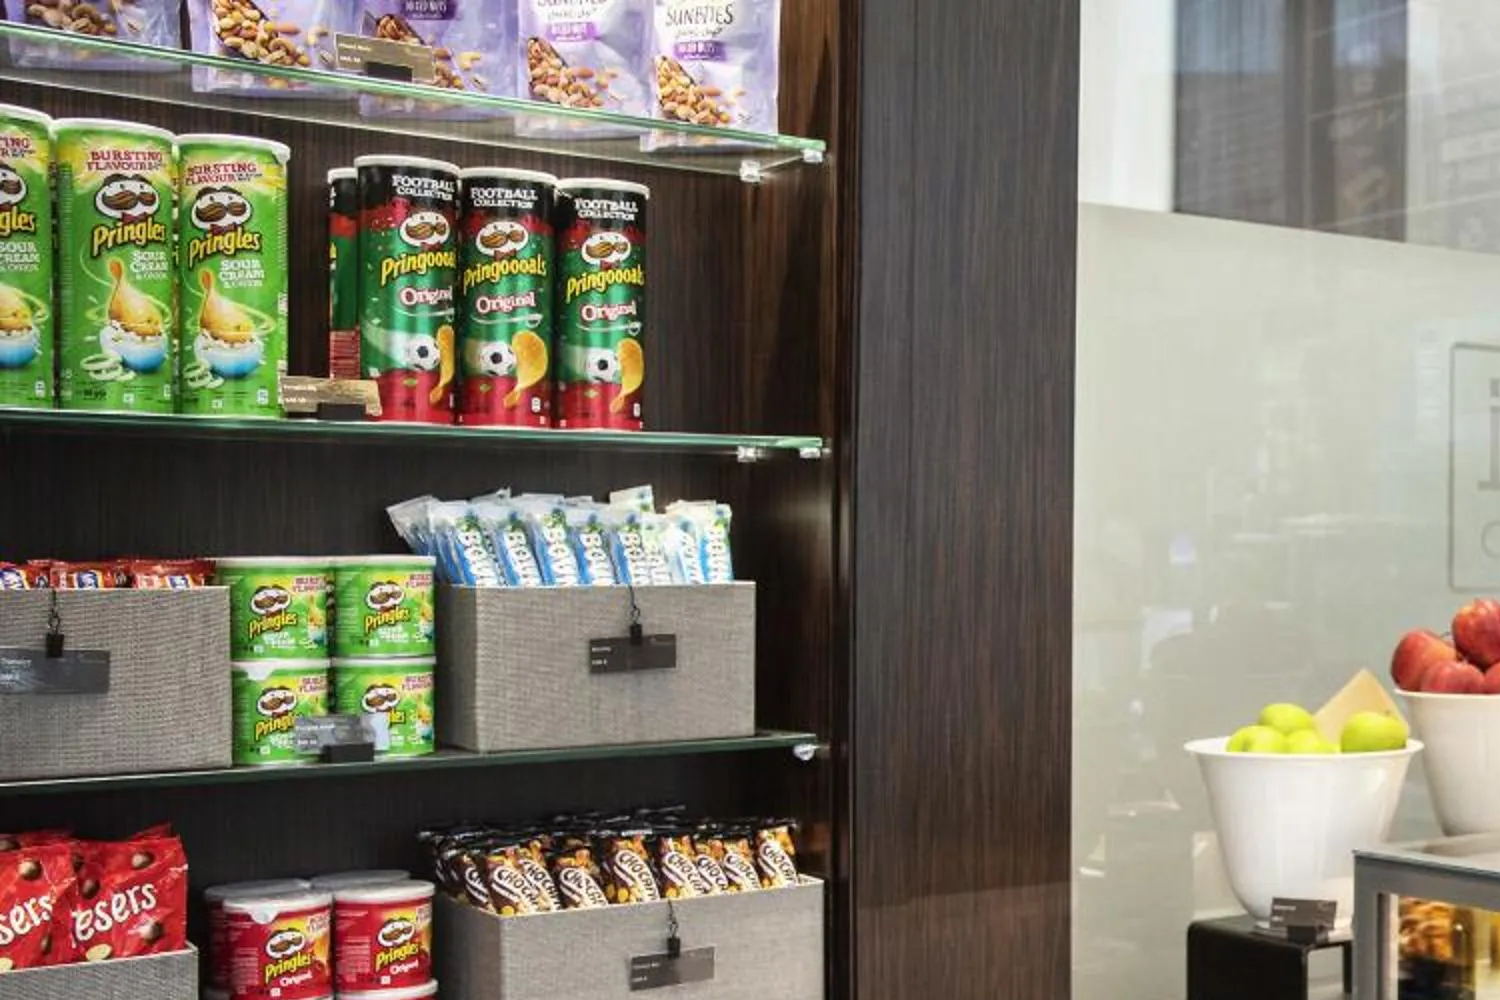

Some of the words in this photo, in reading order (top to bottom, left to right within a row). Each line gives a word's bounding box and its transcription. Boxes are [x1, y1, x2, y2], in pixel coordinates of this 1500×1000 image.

[664, 3, 734, 27] SUNBITES
[0, 136, 31, 149] TING
[89, 150, 164, 162] BURSTING
[186, 163, 257, 176] BURSTING
[392, 174, 455, 193] FOOTBALL
[471, 187, 538, 201] FOOTBALL
[473, 198, 535, 210] COLLECTION
[574, 198, 638, 213] FOOTBALL
[0, 205, 35, 238] gles
[577, 210, 636, 222] COLLECTION
[90, 215, 166, 258] Pringles
[188, 226, 263, 269] Pringles
[220, 258, 262, 270] SOUR
[475, 290, 537, 315] Original
[580, 299, 637, 322] Original
[248, 607, 297, 639] Pringles
[364, 604, 411, 633] Pringles
[74, 880, 158, 944] esers
[264, 950, 313, 985] Pringles
[374, 941, 420, 973] Pringles
